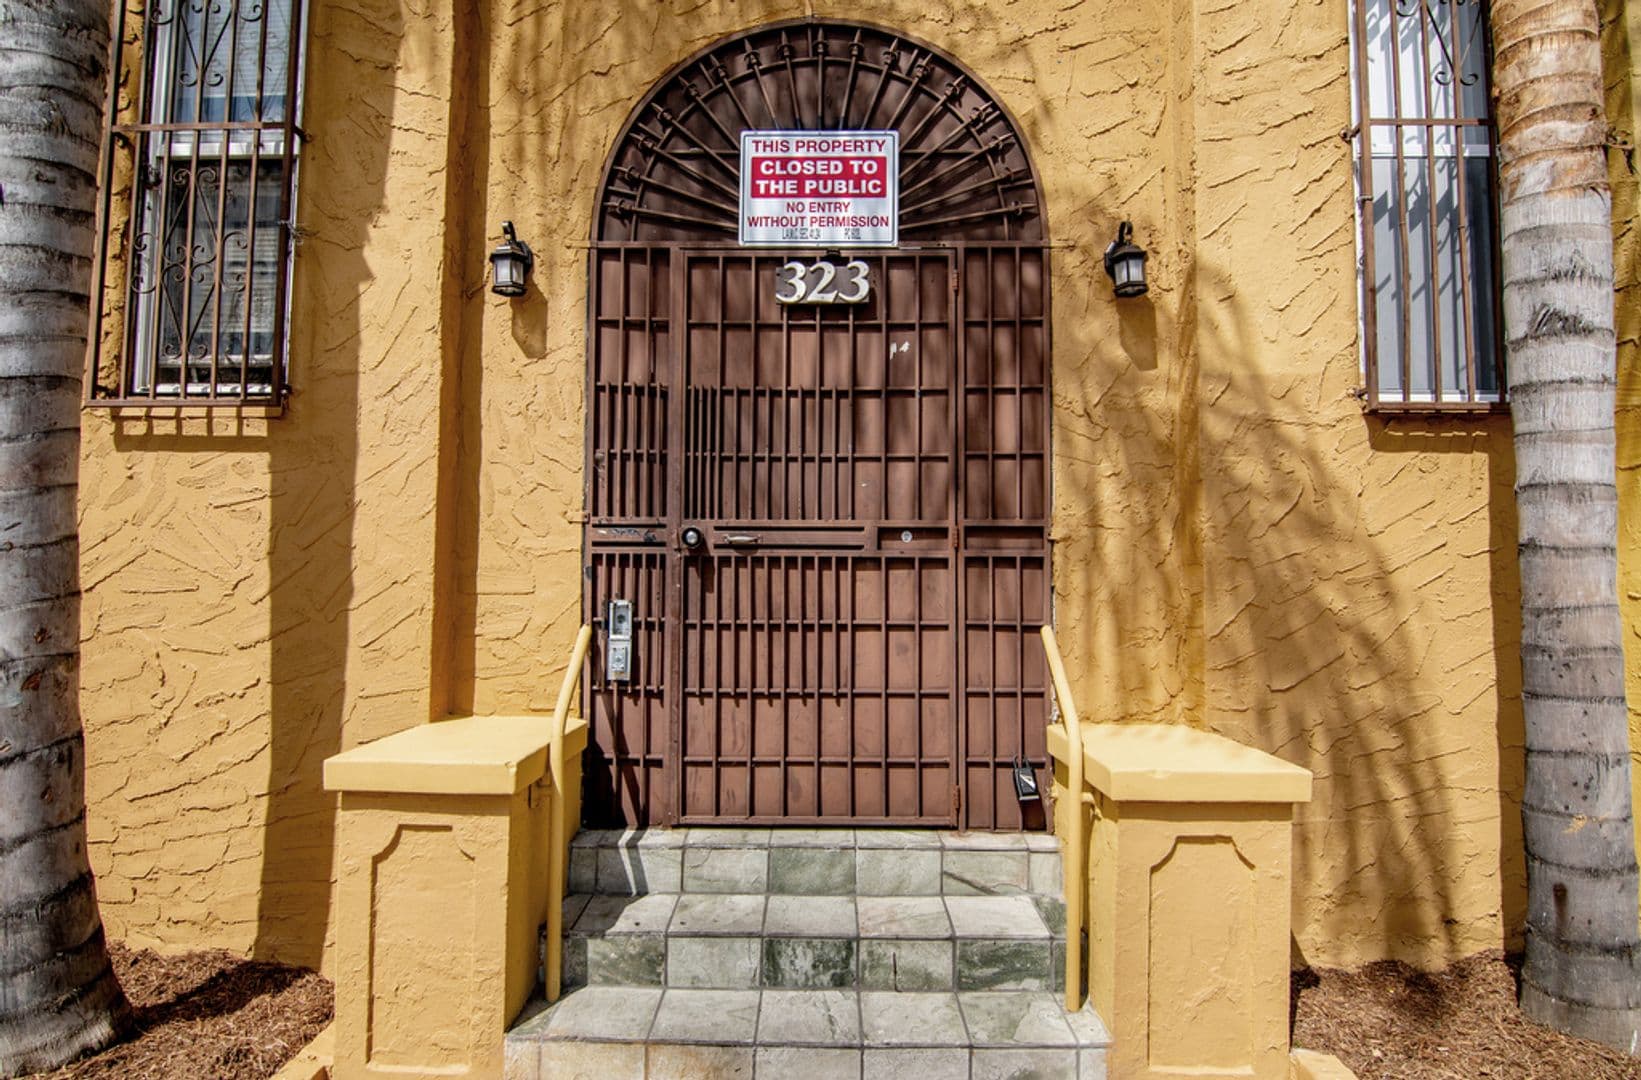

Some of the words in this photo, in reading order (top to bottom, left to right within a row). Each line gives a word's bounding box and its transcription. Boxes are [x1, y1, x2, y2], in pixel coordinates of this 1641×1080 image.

[752, 139, 790, 152] THIS
[795, 139, 886, 152] PROPERTY
[760, 160, 843, 175] CLOSED
[850, 160, 878, 175] TO
[756, 180, 797, 194] THE
[805, 180, 882, 194] PUBLIC
[786, 202, 805, 213] NO
[809, 202, 850, 213] ENTRY
[747, 216, 805, 227] WITHOUT
[810, 216, 889, 227] PERMISSION
[776, 261, 870, 303] 323
